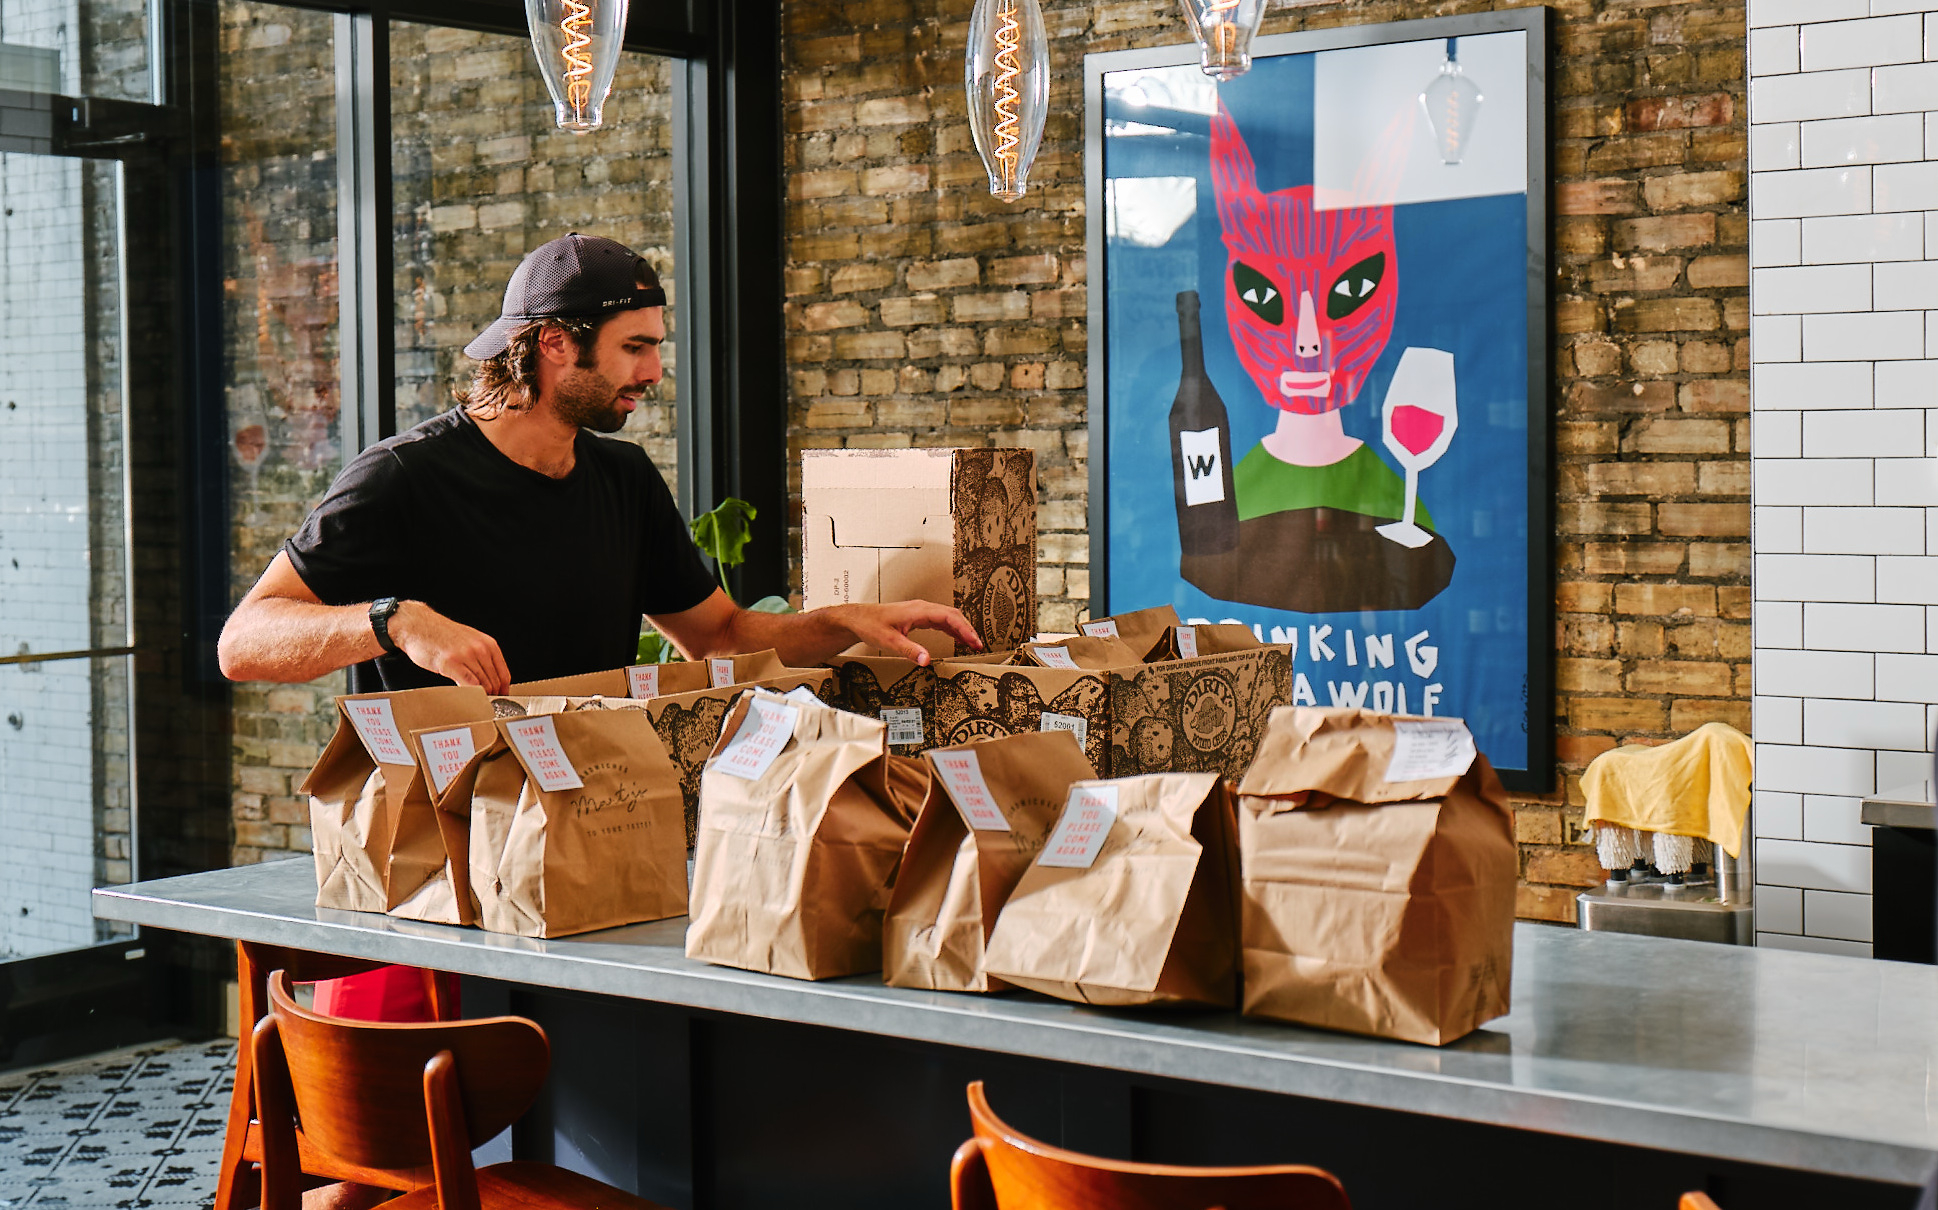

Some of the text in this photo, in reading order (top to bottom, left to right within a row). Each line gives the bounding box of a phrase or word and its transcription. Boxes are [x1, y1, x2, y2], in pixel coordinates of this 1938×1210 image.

[602, 297, 632, 307] DRI-FIT
[1187, 454, 1215, 480] W
[984, 583, 996, 616] POTATO
[1166, 663, 1184, 671] DISPLAY
[1184, 660, 1202, 669] REMOVE
[1202, 658, 1215, 666] FRONT
[635, 672, 653, 683] THANK
[639, 683, 650, 692] YOU
[1185, 678, 1232, 710] DIRTY
[1327, 681, 1443, 717] WOLF
[356, 706, 382, 715] THANK
[760, 708, 788, 724] THANK
[366, 718, 381, 726] YOU
[365, 727, 392, 737] PLEASE
[518, 725, 545, 737] THANK
[758, 723, 777, 736] YOU
[374, 737, 395, 746] COME
[432, 737, 462, 749] THANK
[528, 738, 545, 747] YOU
[743, 732, 777, 748] PLEASE
[379, 746, 402, 755] AGAIN
[441, 750, 459, 760] YOU
[528, 748, 557, 759] PLEASE
[740, 744, 765, 758] COME
[438, 760, 468, 774] PLEAS
[538, 759, 560, 769] COME
[731, 755, 760, 768] AGAIN
[943, 759, 969, 769] THANK
[544, 769, 568, 780] AGAIN
[580, 763, 628, 780] ANDWICHES
[954, 772, 971, 782] YOU
[955, 784, 983, 795] PLEASE
[965, 797, 986, 807] COME
[971, 809, 995, 818] AGAIN
[1081, 810, 1101, 820] YOU
[587, 830, 597, 838] TO
[601, 825, 622, 835] YOUR
[1066, 822, 1103, 833] PLEASE
[1064, 835, 1092, 844] COME
[1056, 846, 1087, 856] AGAIN
